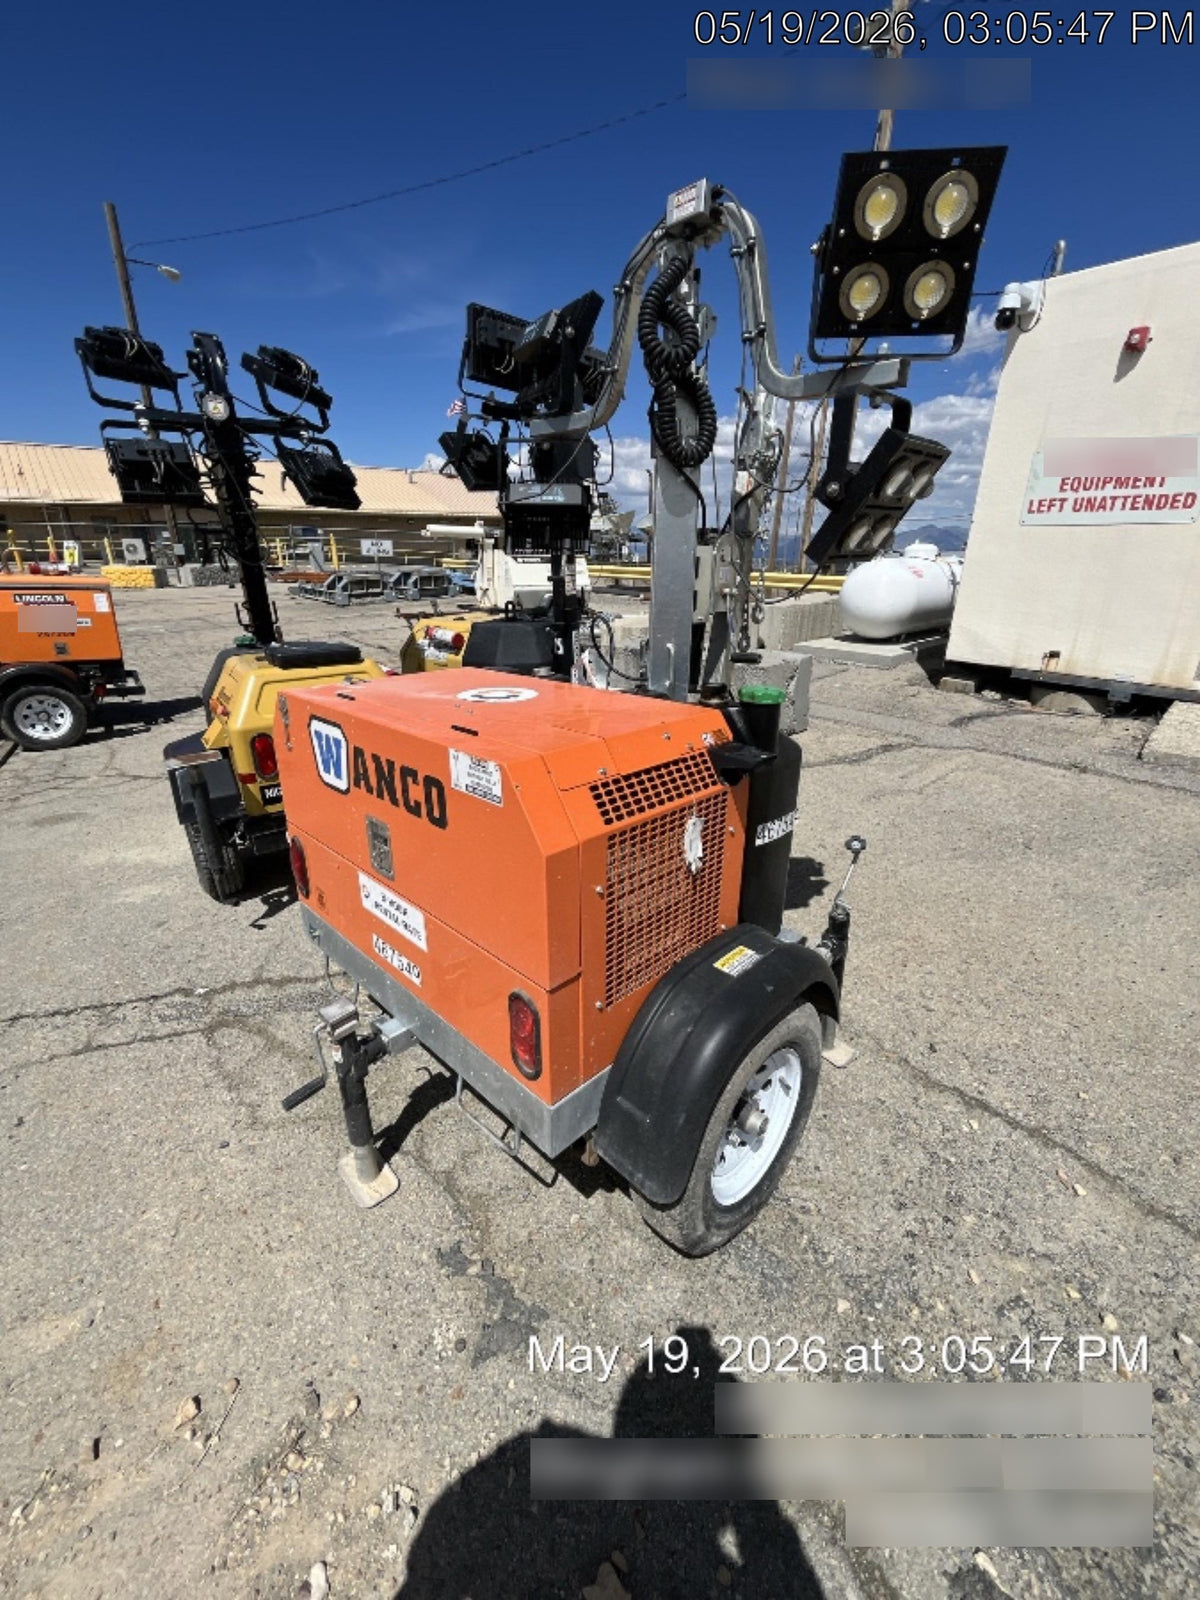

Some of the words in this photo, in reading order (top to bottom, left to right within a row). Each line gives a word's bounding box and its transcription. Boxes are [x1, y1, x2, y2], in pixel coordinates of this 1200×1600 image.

[1027, 498, 1069, 515] LEFT
[1071, 491, 1198, 514] UNATTENDED
[312, 728, 449, 830] WANCO
